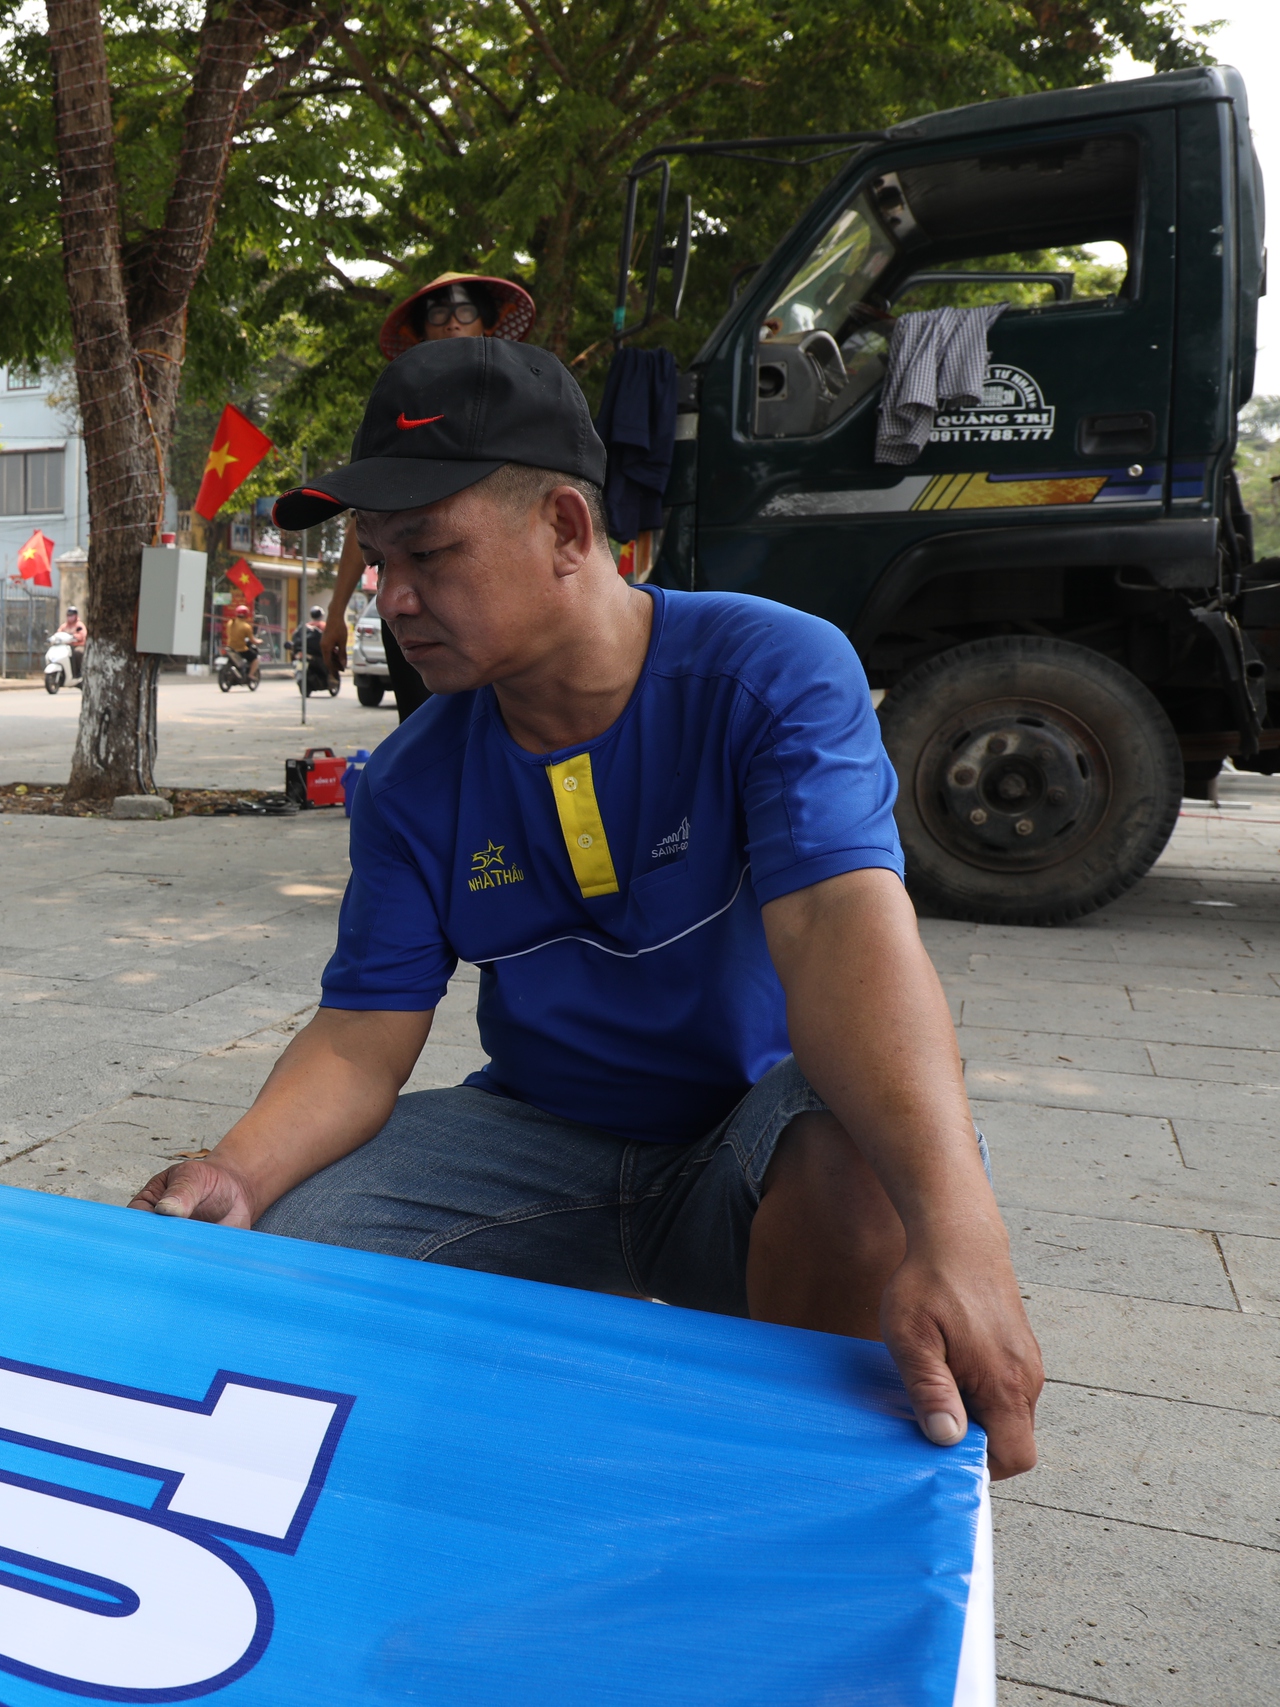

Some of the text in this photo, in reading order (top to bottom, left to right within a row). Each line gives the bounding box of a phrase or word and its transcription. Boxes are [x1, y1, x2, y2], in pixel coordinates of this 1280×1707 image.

[936, 411, 1050, 427] QUẢNG TRỊ
[929, 428, 1054, 443] 0911.788.777
[468, 862, 525, 892] NHÀ THẦU
